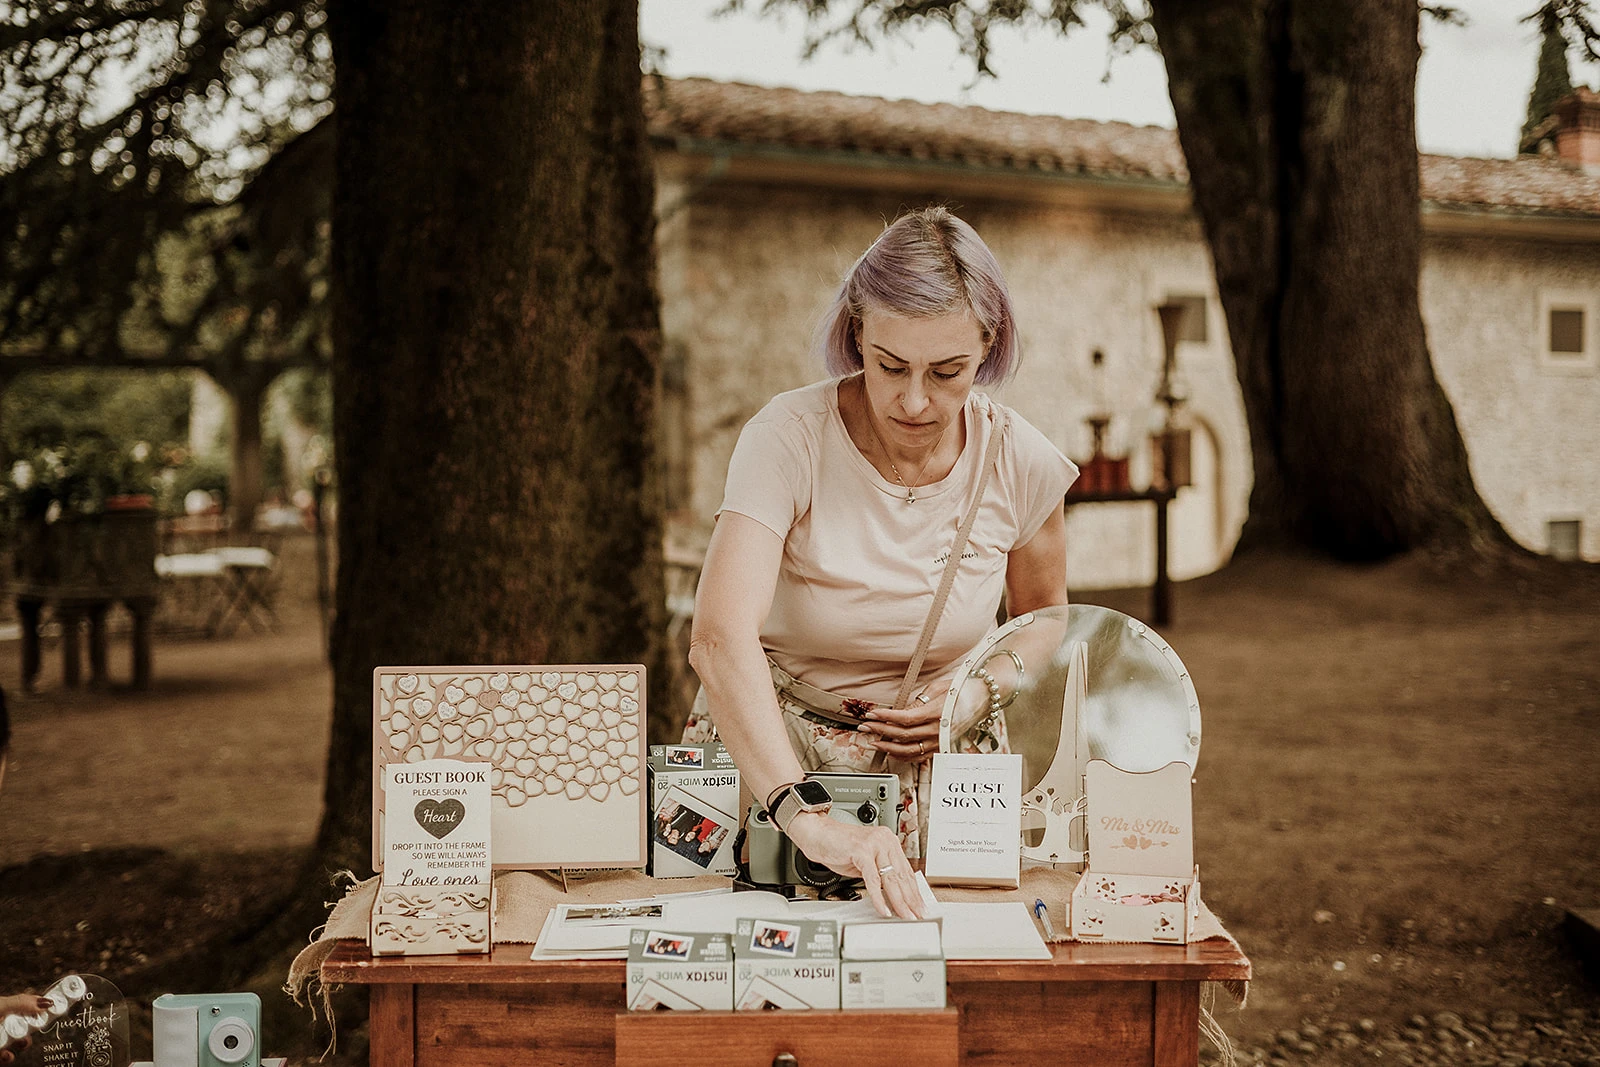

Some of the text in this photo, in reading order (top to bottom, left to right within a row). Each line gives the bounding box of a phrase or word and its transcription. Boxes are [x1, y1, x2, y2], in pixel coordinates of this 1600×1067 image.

[394, 771, 486, 784] GUEST BOOK
[678, 776, 736, 788] instax WIDE
[657, 781, 669, 790] 20
[948, 782, 1005, 794] GUEST
[443, 788, 461, 796] SIGN
[461, 788, 468, 796] A
[941, 797, 1007, 808] SIGN IN
[423, 808, 457, 824] Heart
[1100, 816, 1181, 836] Mr & Mrs
[392, 843, 415, 851] DROP
[445, 842, 460, 850] THE
[977, 846, 1005, 854] Blessings
[412, 852, 423, 860] SO
[423, 852, 436, 860] WE
[457, 851, 487, 859] ALWAYS
[427, 861, 470, 869] REMEMBER
[397, 868, 481, 886] Love ones
[631, 974, 644, 984] 20
[656, 971, 728, 984] instax WIDE
[765, 967, 835, 981] instax WIDE
[43, 1043, 64, 1053] SNAP
[43, 1052, 69, 1062] SHAKE
